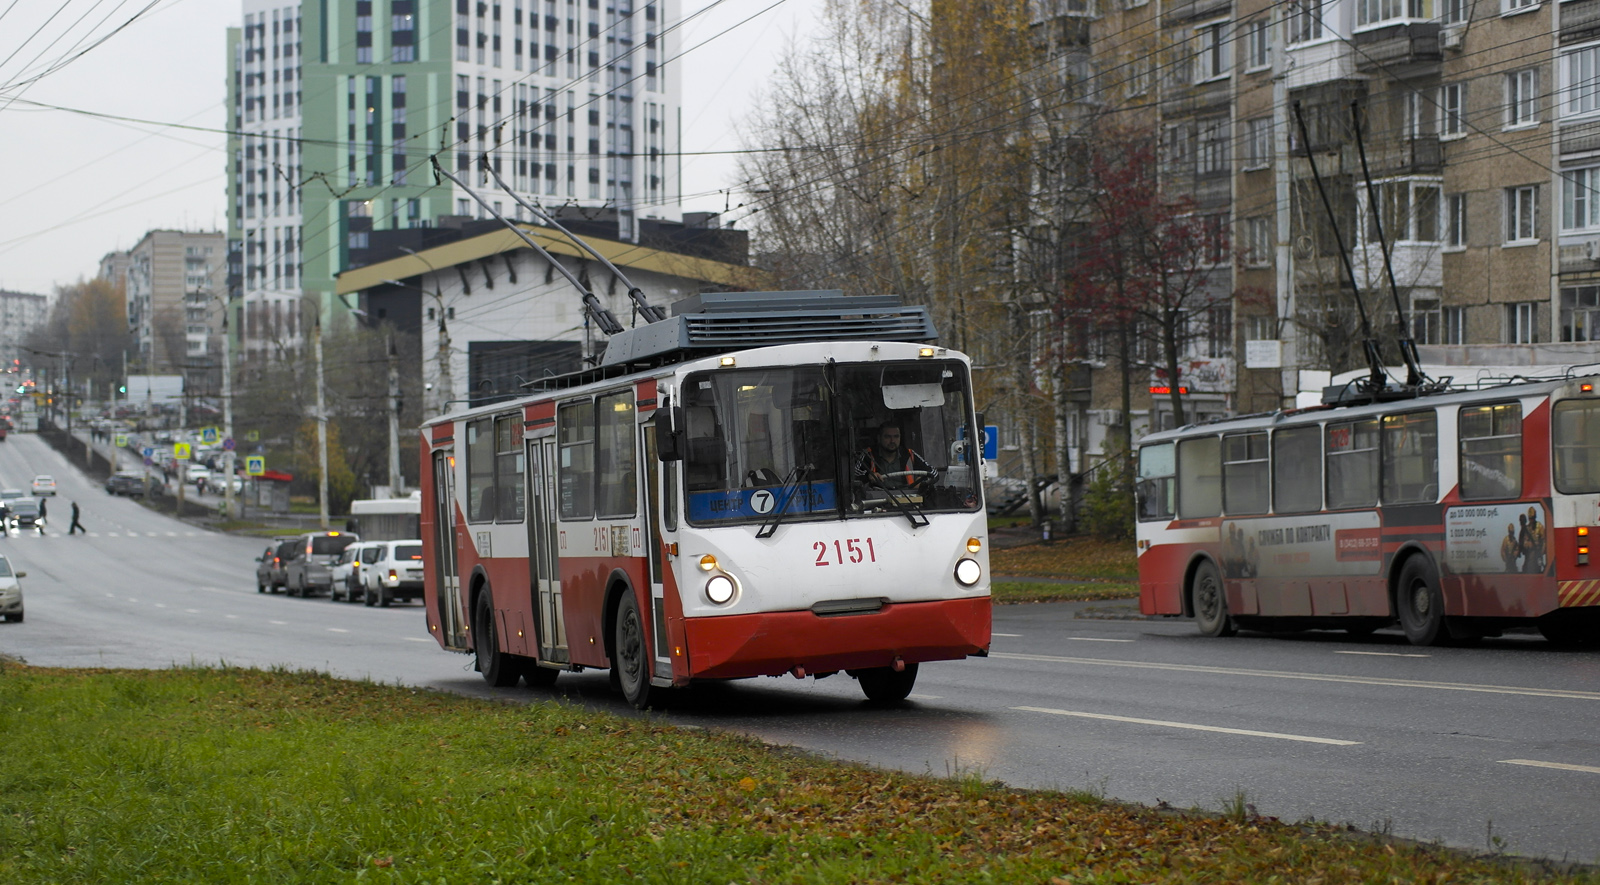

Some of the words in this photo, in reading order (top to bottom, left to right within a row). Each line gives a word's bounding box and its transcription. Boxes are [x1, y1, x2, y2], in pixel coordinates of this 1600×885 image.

[709, 498, 744, 513] ЦЕНТР
[756, 493, 770, 511] 7
[593, 526, 609, 552] 2151
[813, 537, 876, 567] 2151
